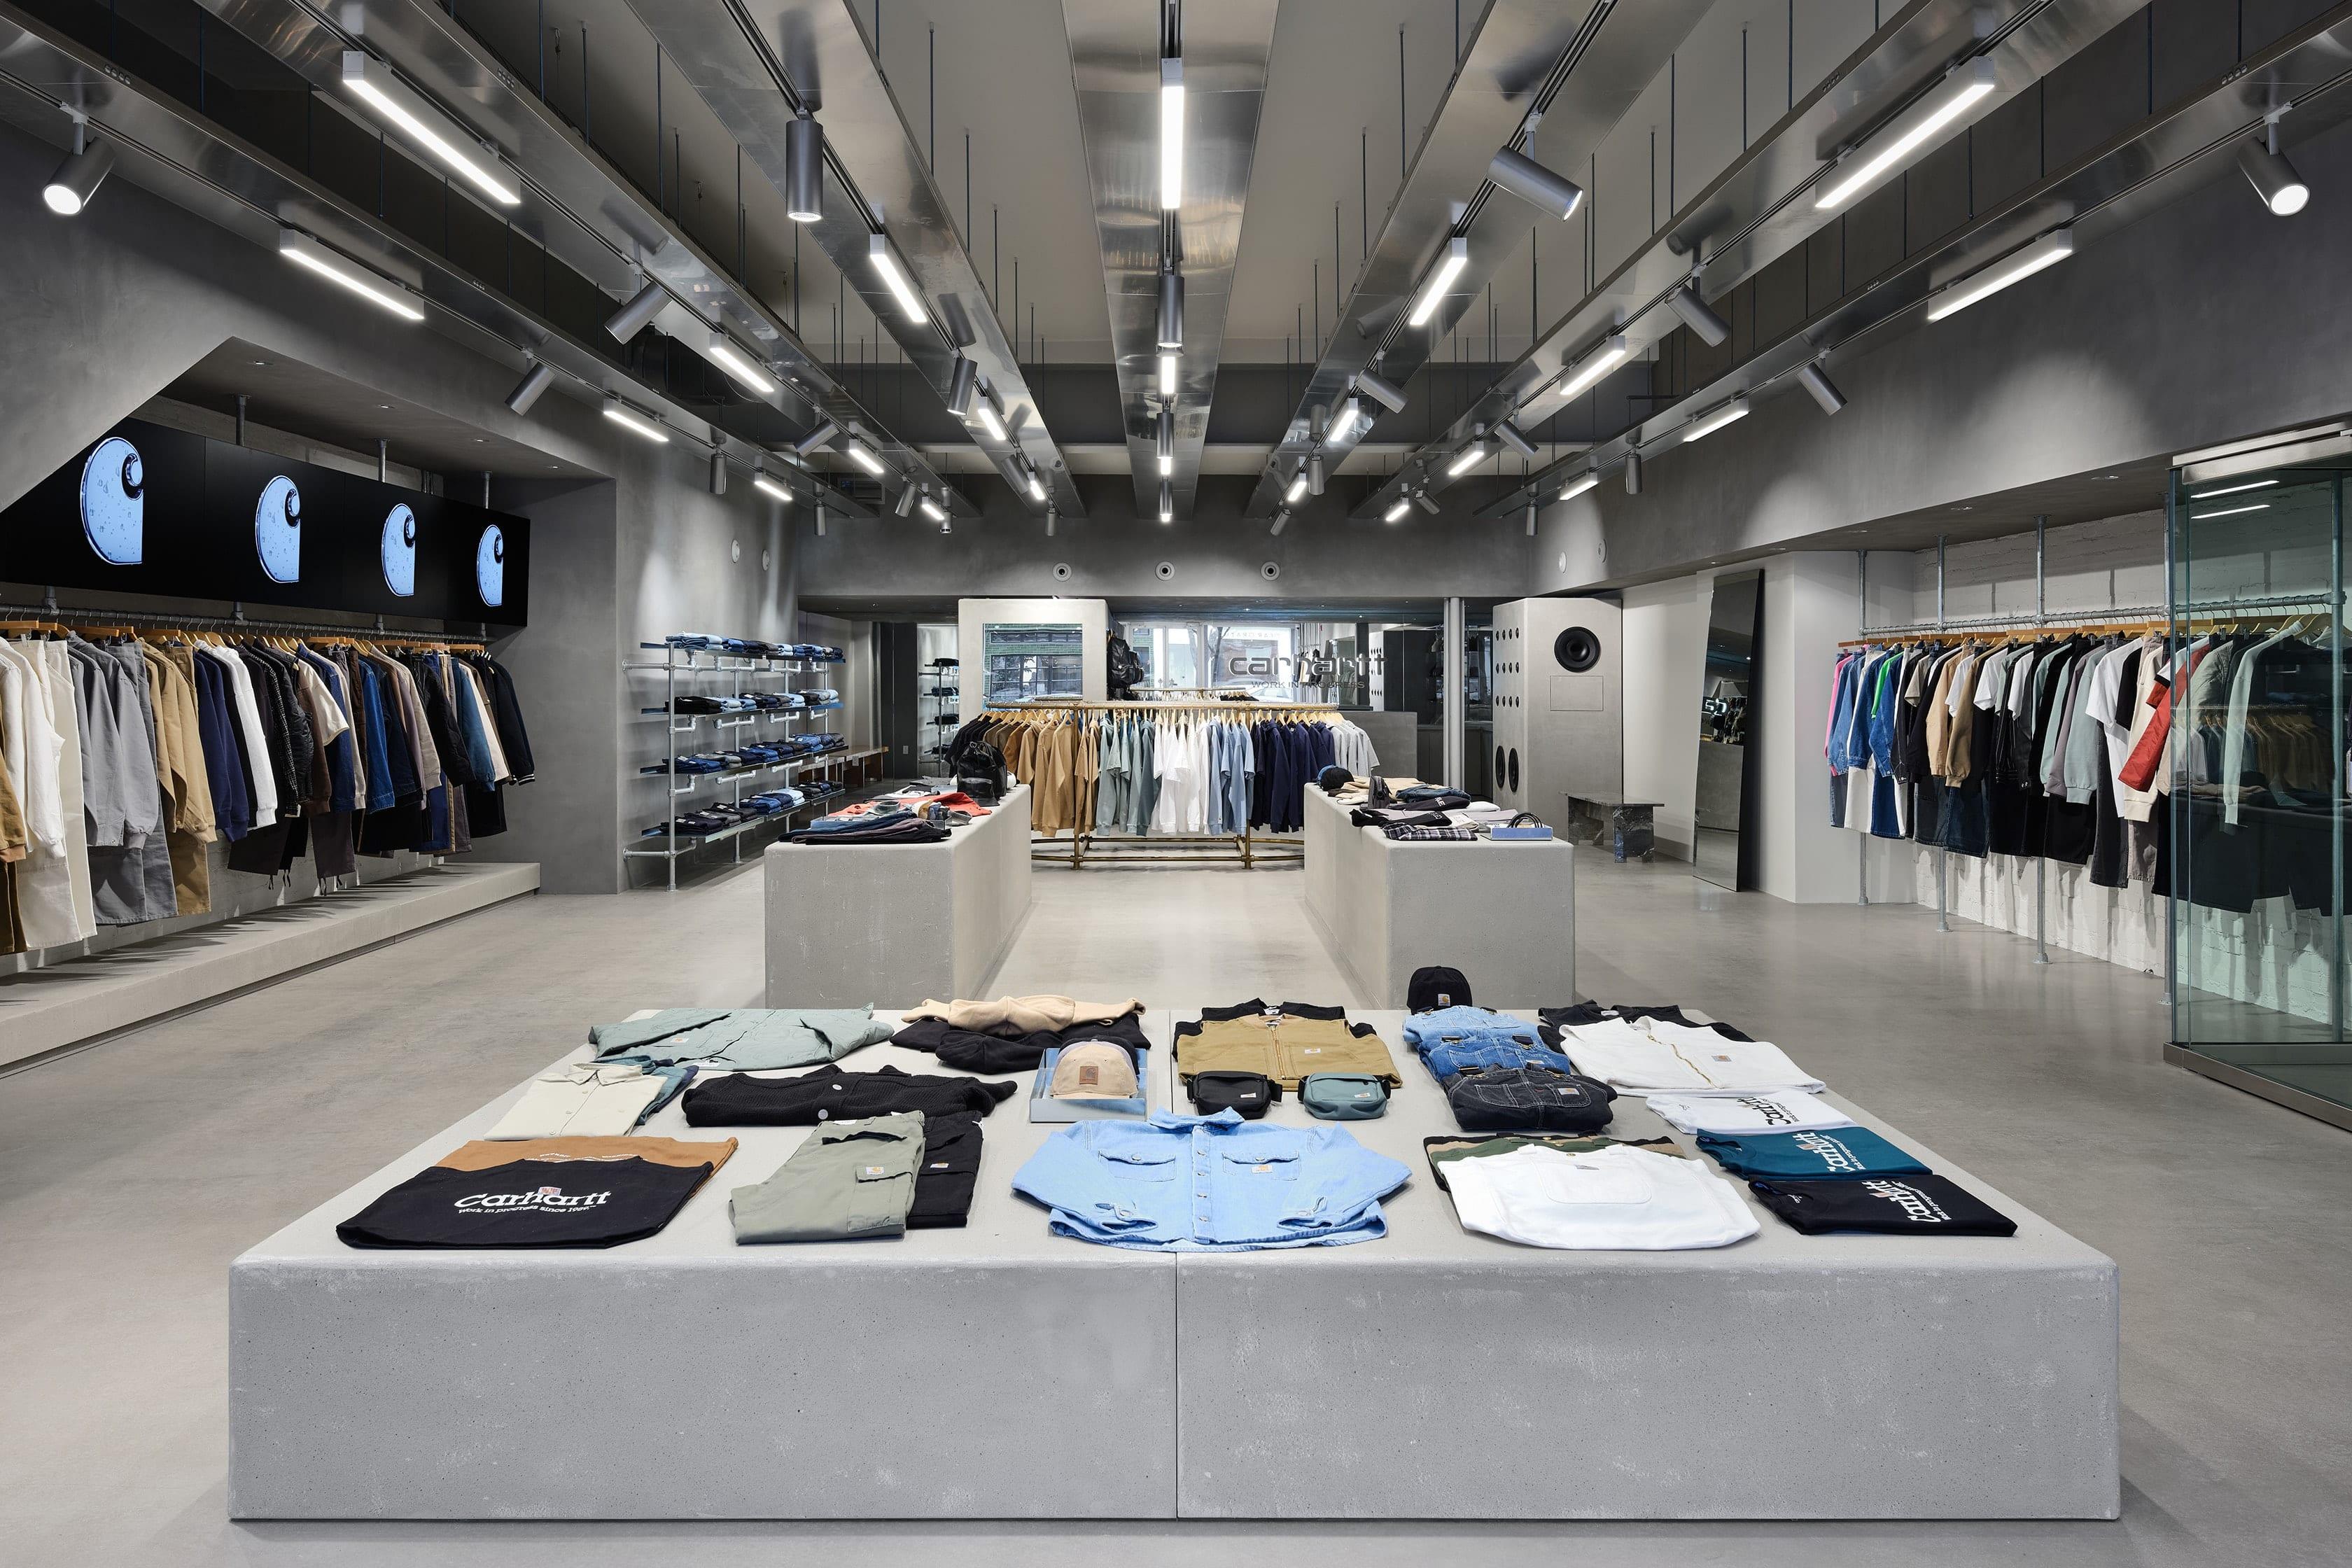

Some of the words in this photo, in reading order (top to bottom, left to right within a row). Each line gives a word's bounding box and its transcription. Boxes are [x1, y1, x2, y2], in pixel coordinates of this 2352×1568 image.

[1229, 653, 1387, 676] carhartt
[454, 1191, 612, 1208] Carhartt
[1861, 1180, 1942, 1223] Carhartt
